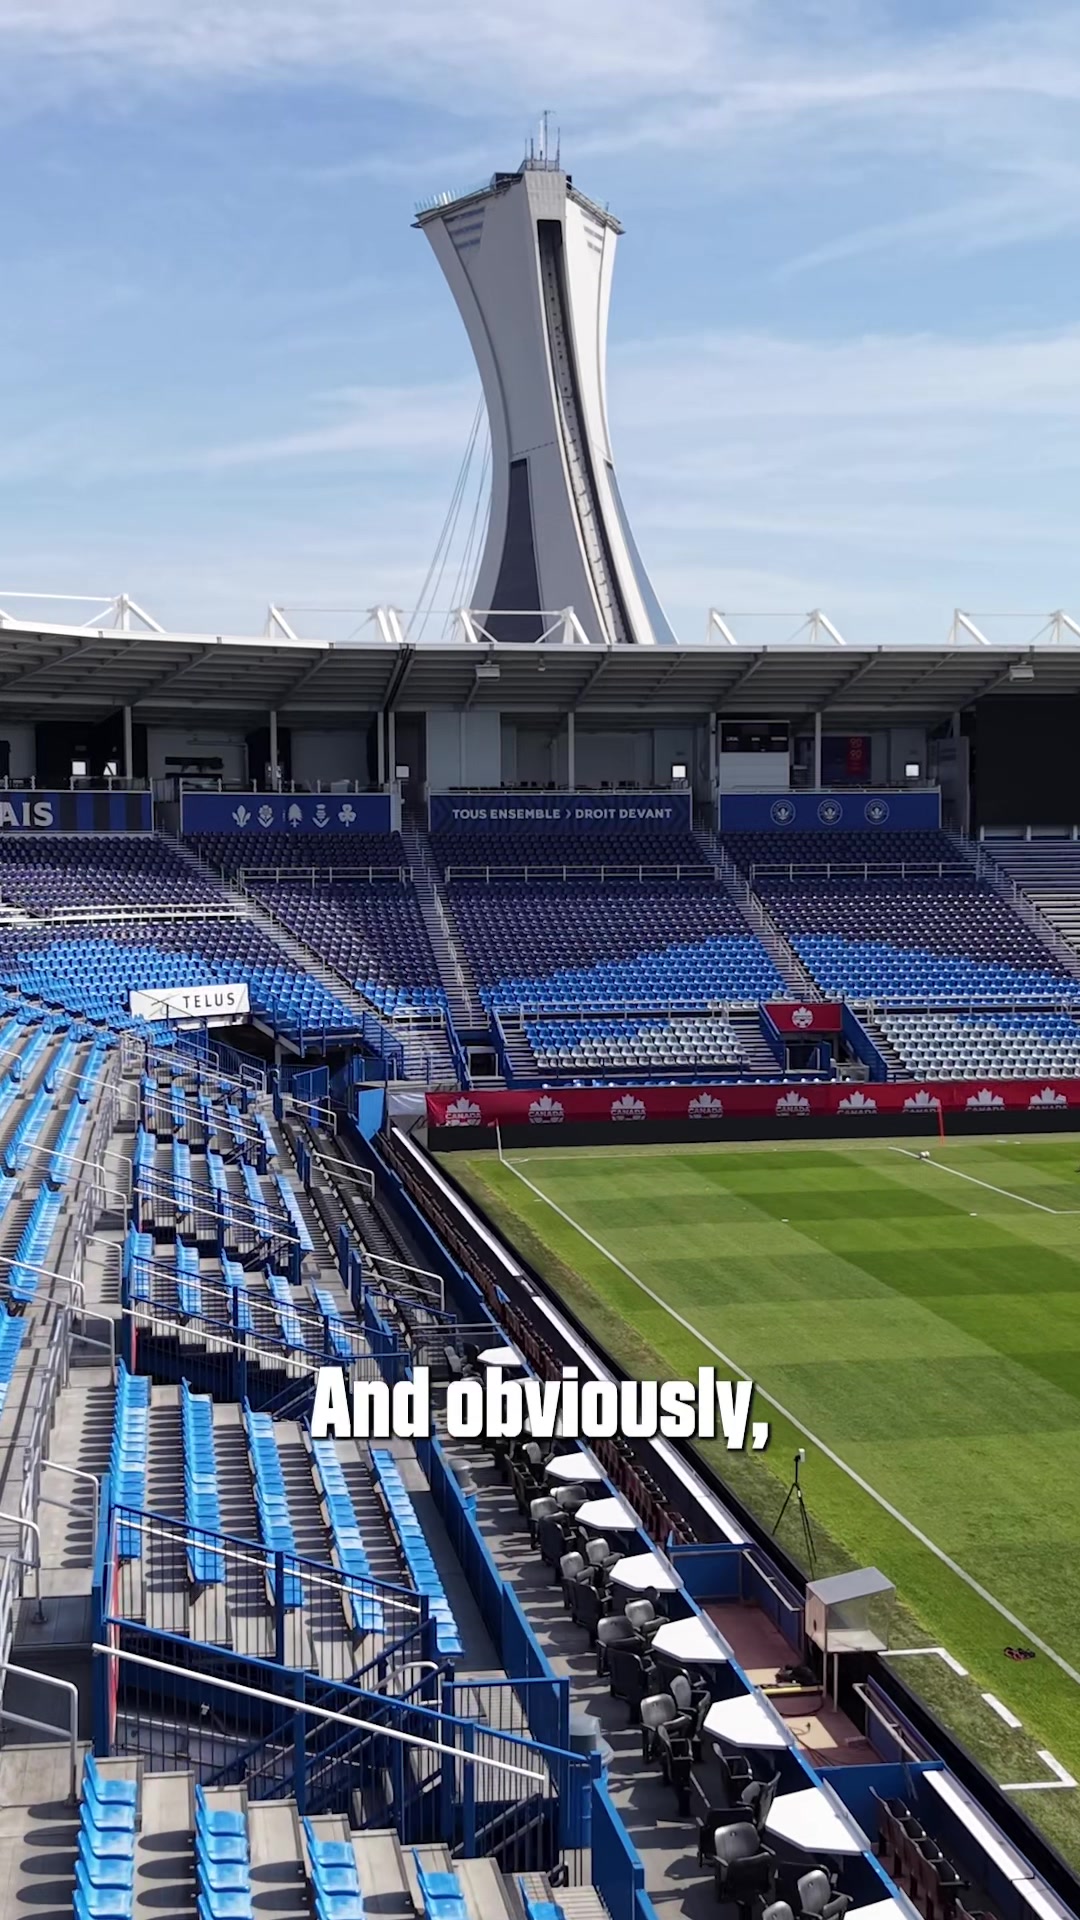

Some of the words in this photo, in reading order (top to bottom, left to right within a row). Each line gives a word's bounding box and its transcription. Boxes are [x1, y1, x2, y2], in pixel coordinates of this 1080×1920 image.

[0, 802, 54, 827] AIS
[452, 809, 487, 819] TOUS
[490, 809, 561, 819] ENSEMBLE
[575, 808, 616, 819] DROIT
[619, 808, 673, 819] DEVANT
[182, 992, 235, 1009] TELUS
[445, 1112, 481, 1120] CANADA
[528, 1110, 565, 1118] CANADA
[610, 1109, 647, 1117] CANADA
[688, 1107, 724, 1116] CANADA
